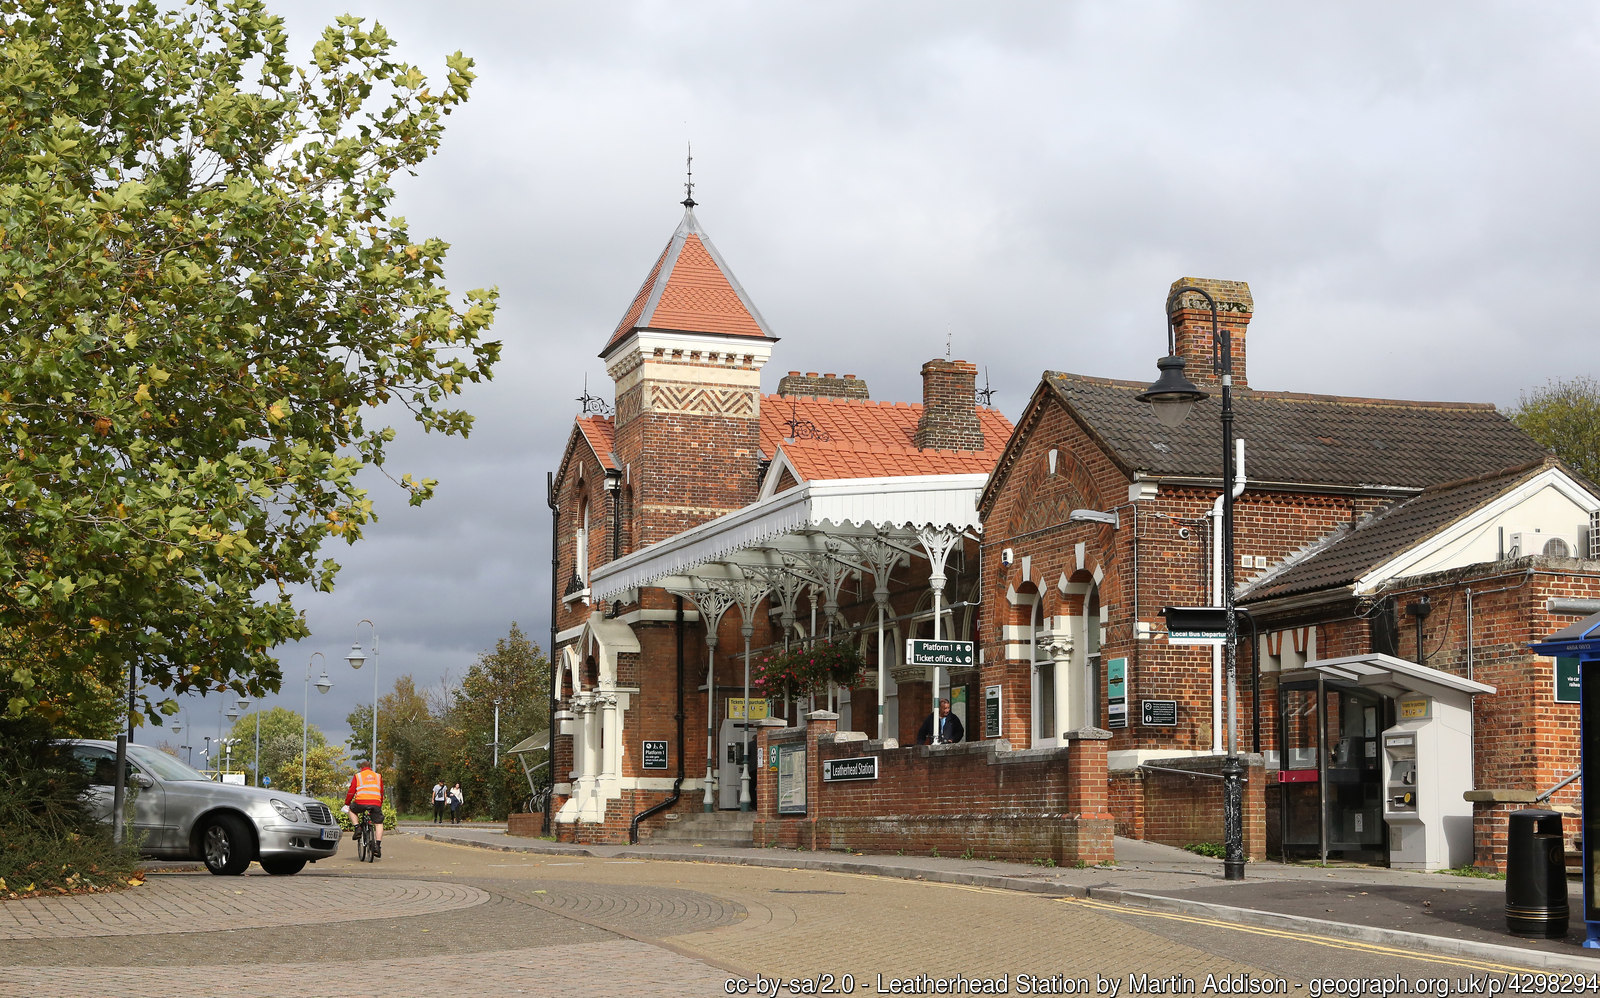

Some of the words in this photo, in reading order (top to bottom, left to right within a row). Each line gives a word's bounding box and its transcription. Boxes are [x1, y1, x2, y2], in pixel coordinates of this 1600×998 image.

[922, 642, 949, 651] Platform
[915, 654, 934, 662] Ticket
[935, 655, 953, 663] office
[832, 763, 858, 777] Leatherhead
[858, 762, 874, 776] Station
